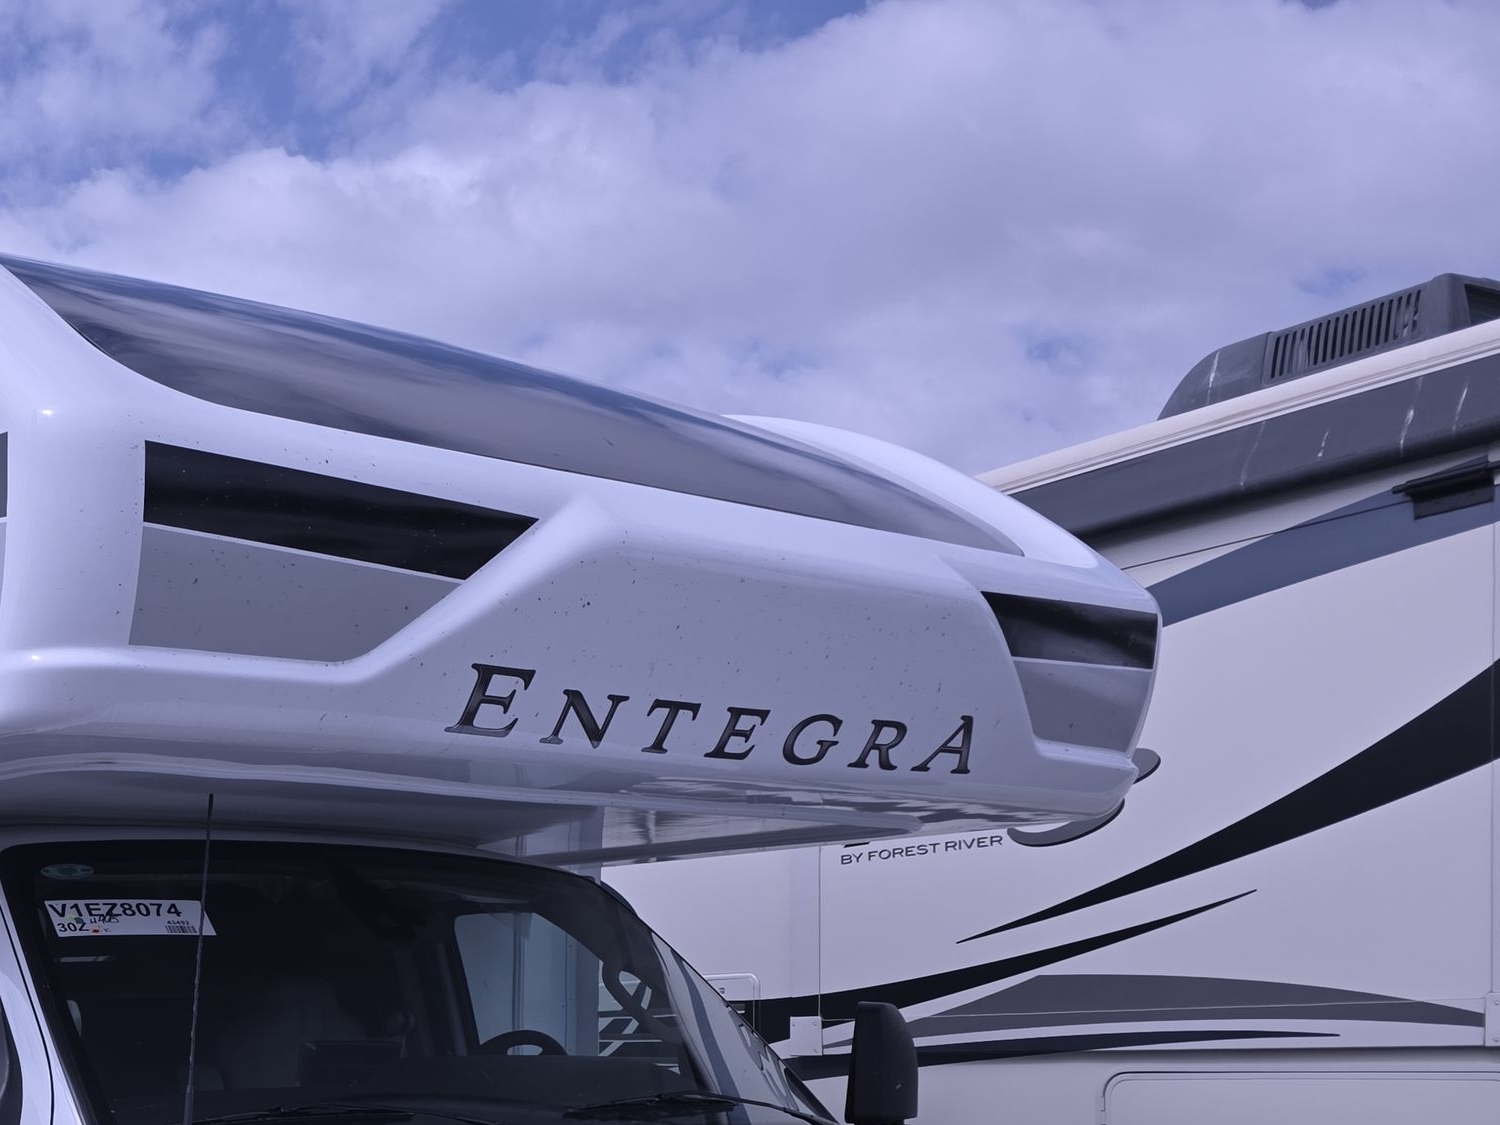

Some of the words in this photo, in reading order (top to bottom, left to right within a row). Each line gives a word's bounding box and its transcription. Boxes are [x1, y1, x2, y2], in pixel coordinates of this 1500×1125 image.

[444, 662, 975, 775] ENTEGRA
[840, 852, 863, 865] BY
[867, 842, 940, 861] FOREST
[944, 835, 1003, 852] RIVER
[48, 903, 182, 918] V1EZ8074
